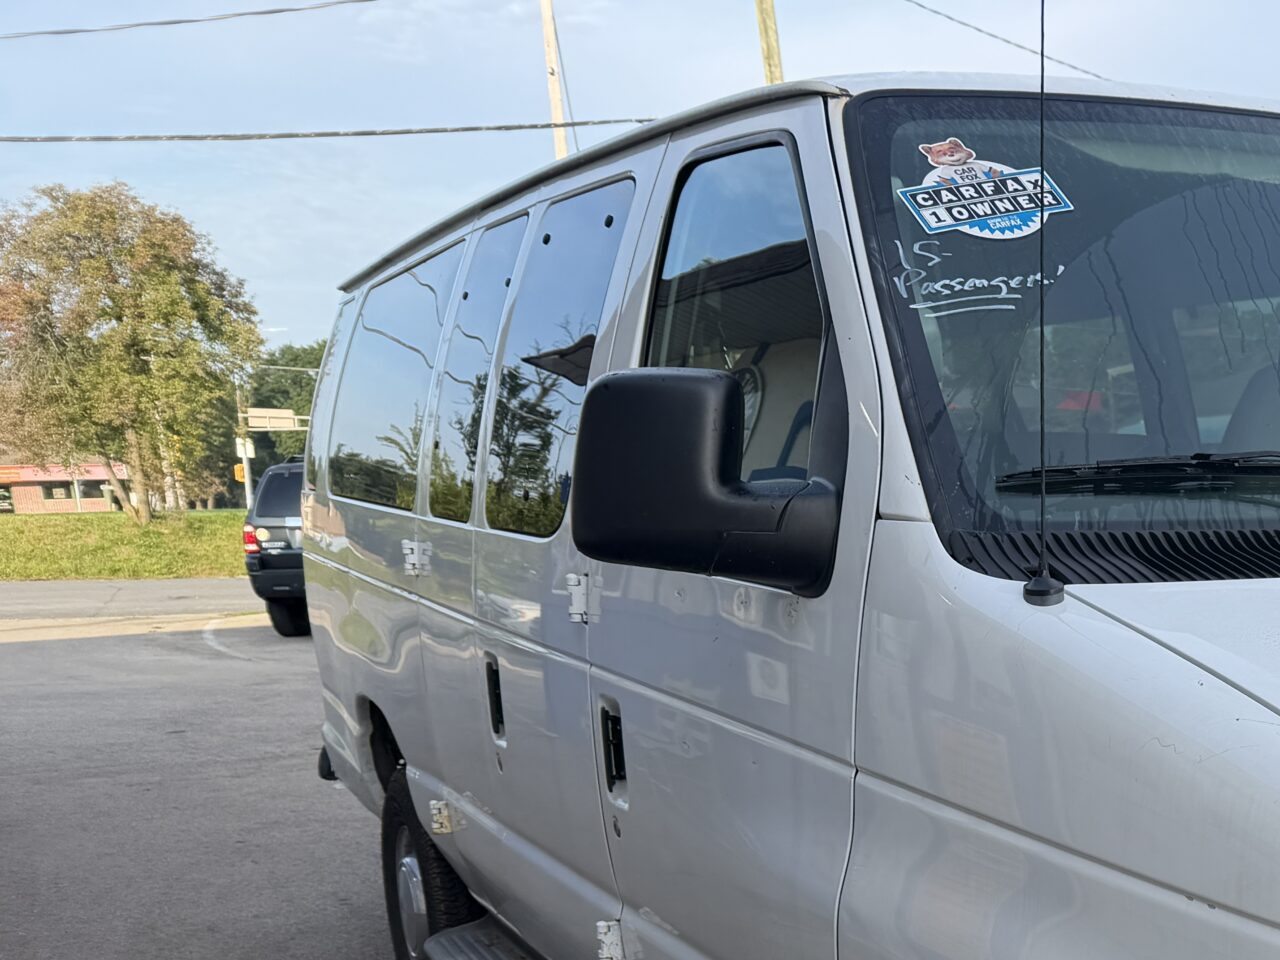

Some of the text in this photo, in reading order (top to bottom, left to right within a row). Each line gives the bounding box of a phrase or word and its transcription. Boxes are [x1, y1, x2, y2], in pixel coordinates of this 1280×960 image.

[953, 166, 977, 176] CAR
[959, 173, 982, 182] FOX
[915, 176, 1045, 206] CARFAX
[928, 192, 1058, 224] 1 OWNER
